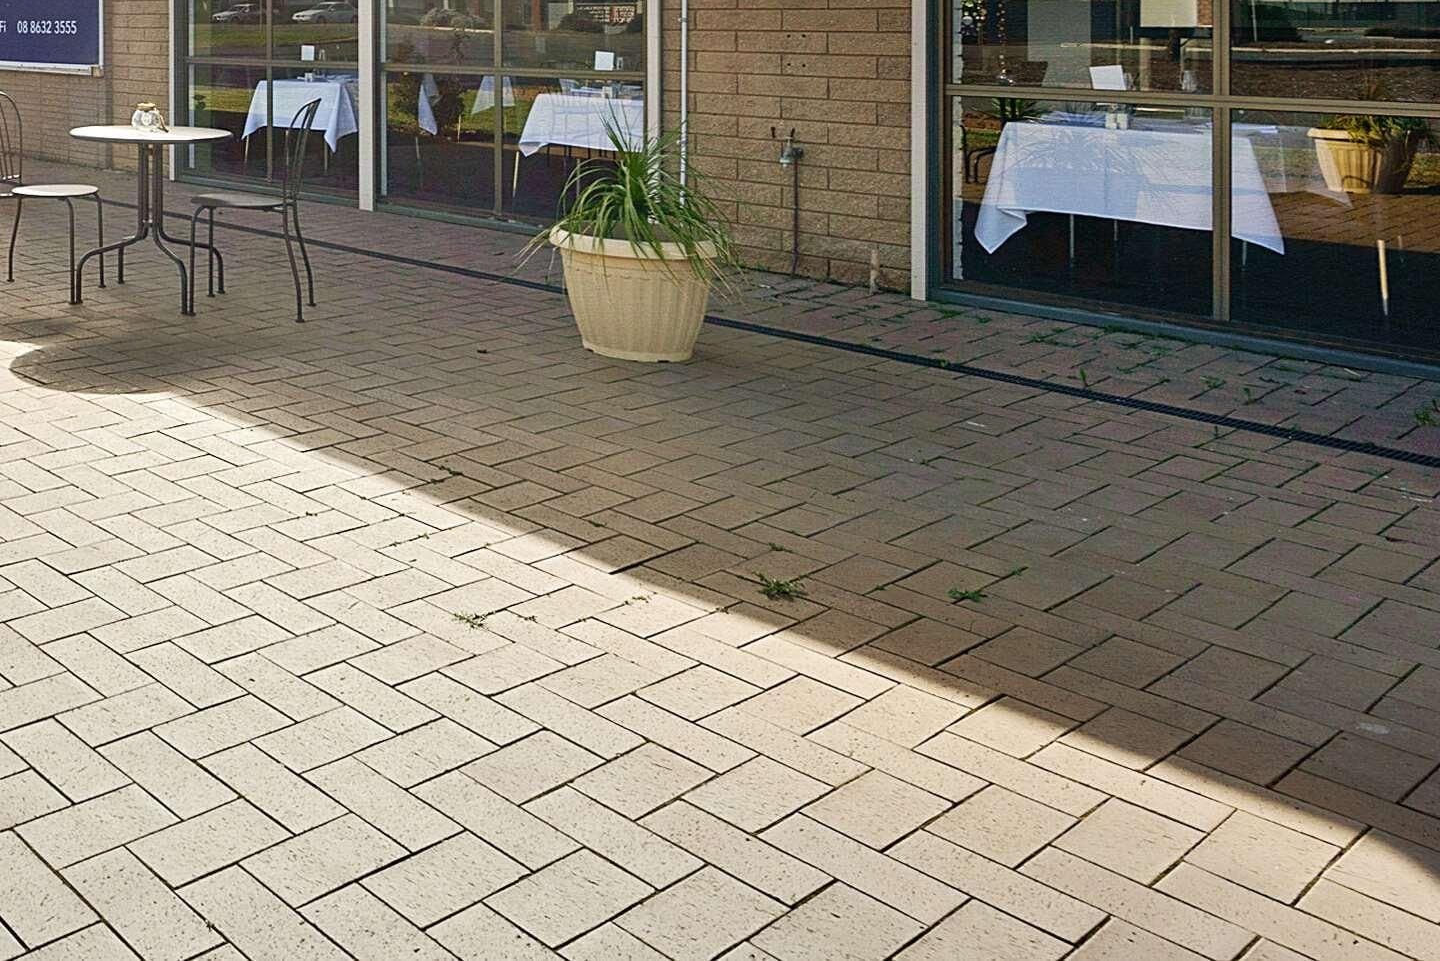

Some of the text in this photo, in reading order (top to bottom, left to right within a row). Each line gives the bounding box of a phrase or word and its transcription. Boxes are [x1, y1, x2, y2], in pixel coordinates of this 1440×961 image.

[17, 20, 28, 33] 08
[30, 20, 52, 34] 8632
[53, 20, 78, 34] 3555
